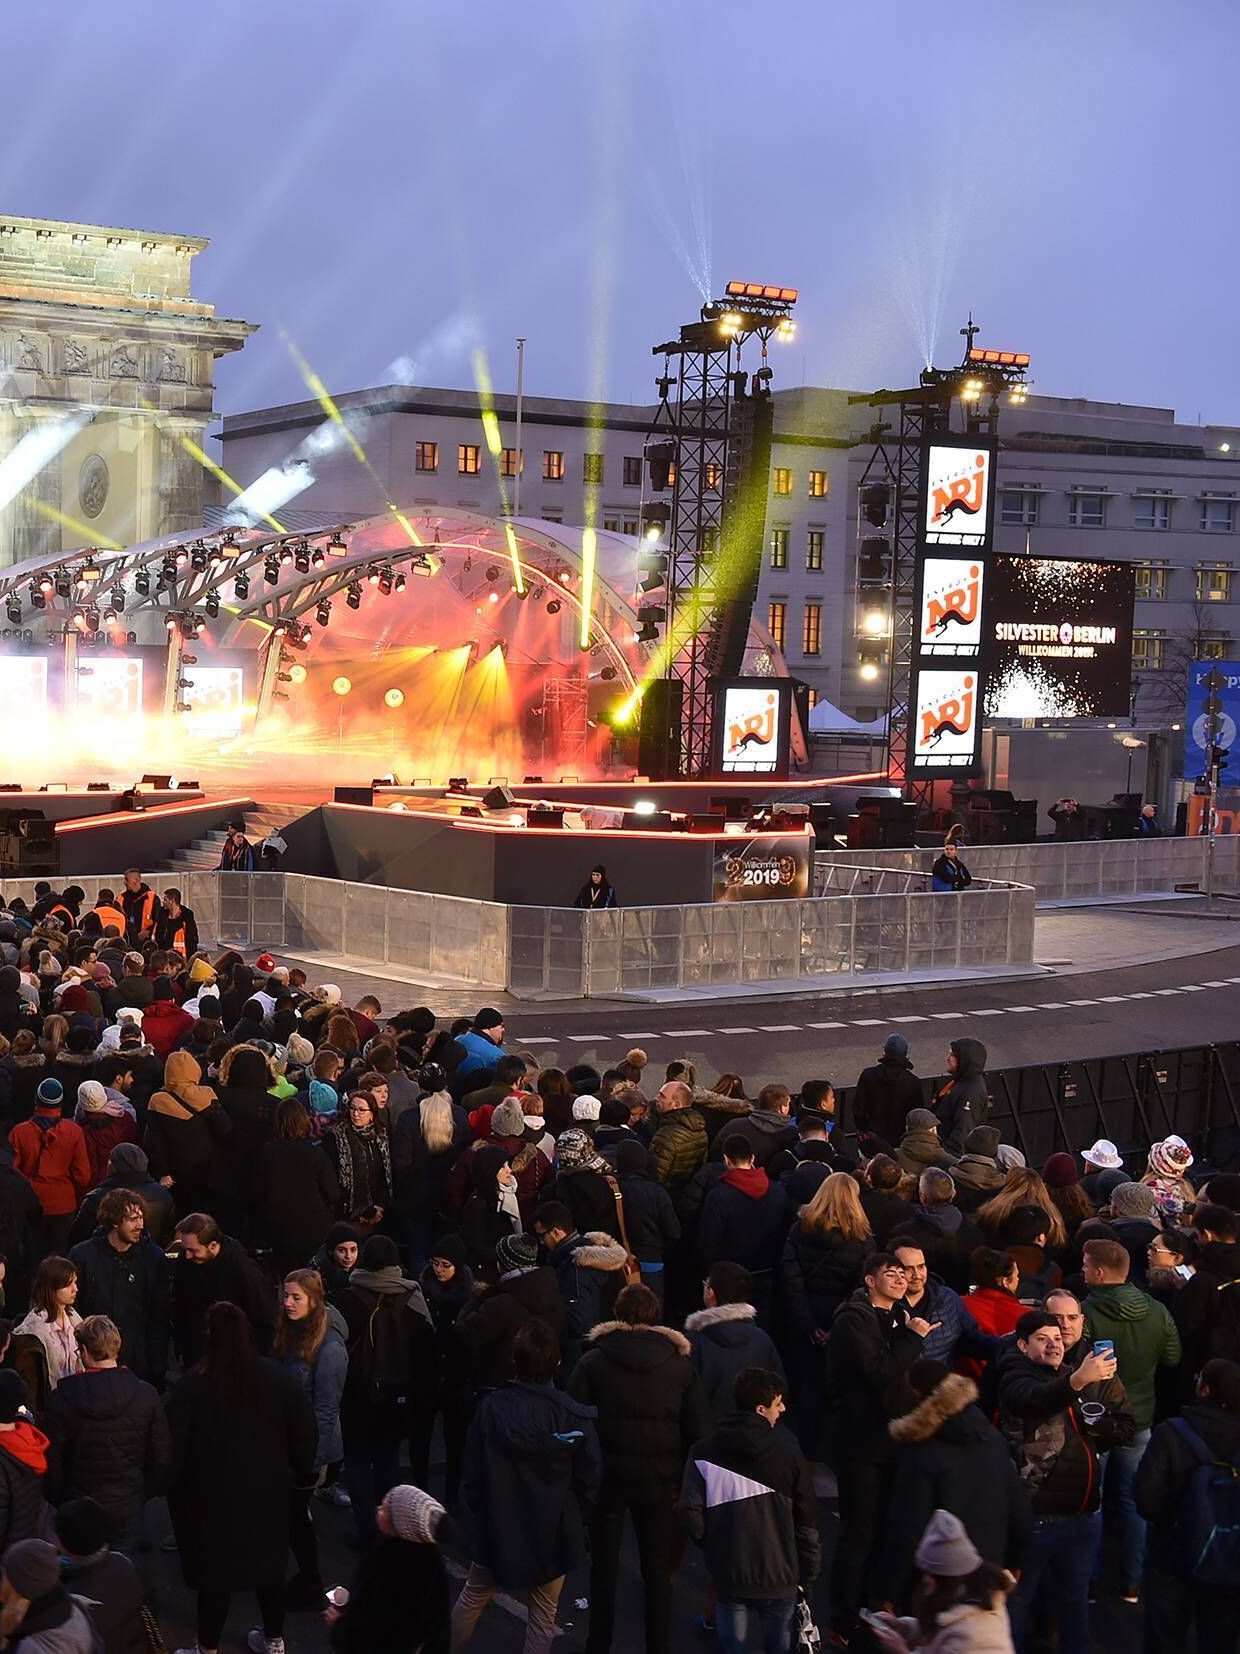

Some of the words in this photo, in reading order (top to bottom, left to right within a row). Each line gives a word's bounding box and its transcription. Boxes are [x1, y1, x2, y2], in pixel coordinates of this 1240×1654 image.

[995, 622, 1058, 641] SILVESTER
[1073, 625, 1116, 643] BERLIN
[1018, 645, 1073, 657] WILLKOMMEN
[743, 869, 780, 886] 2019
